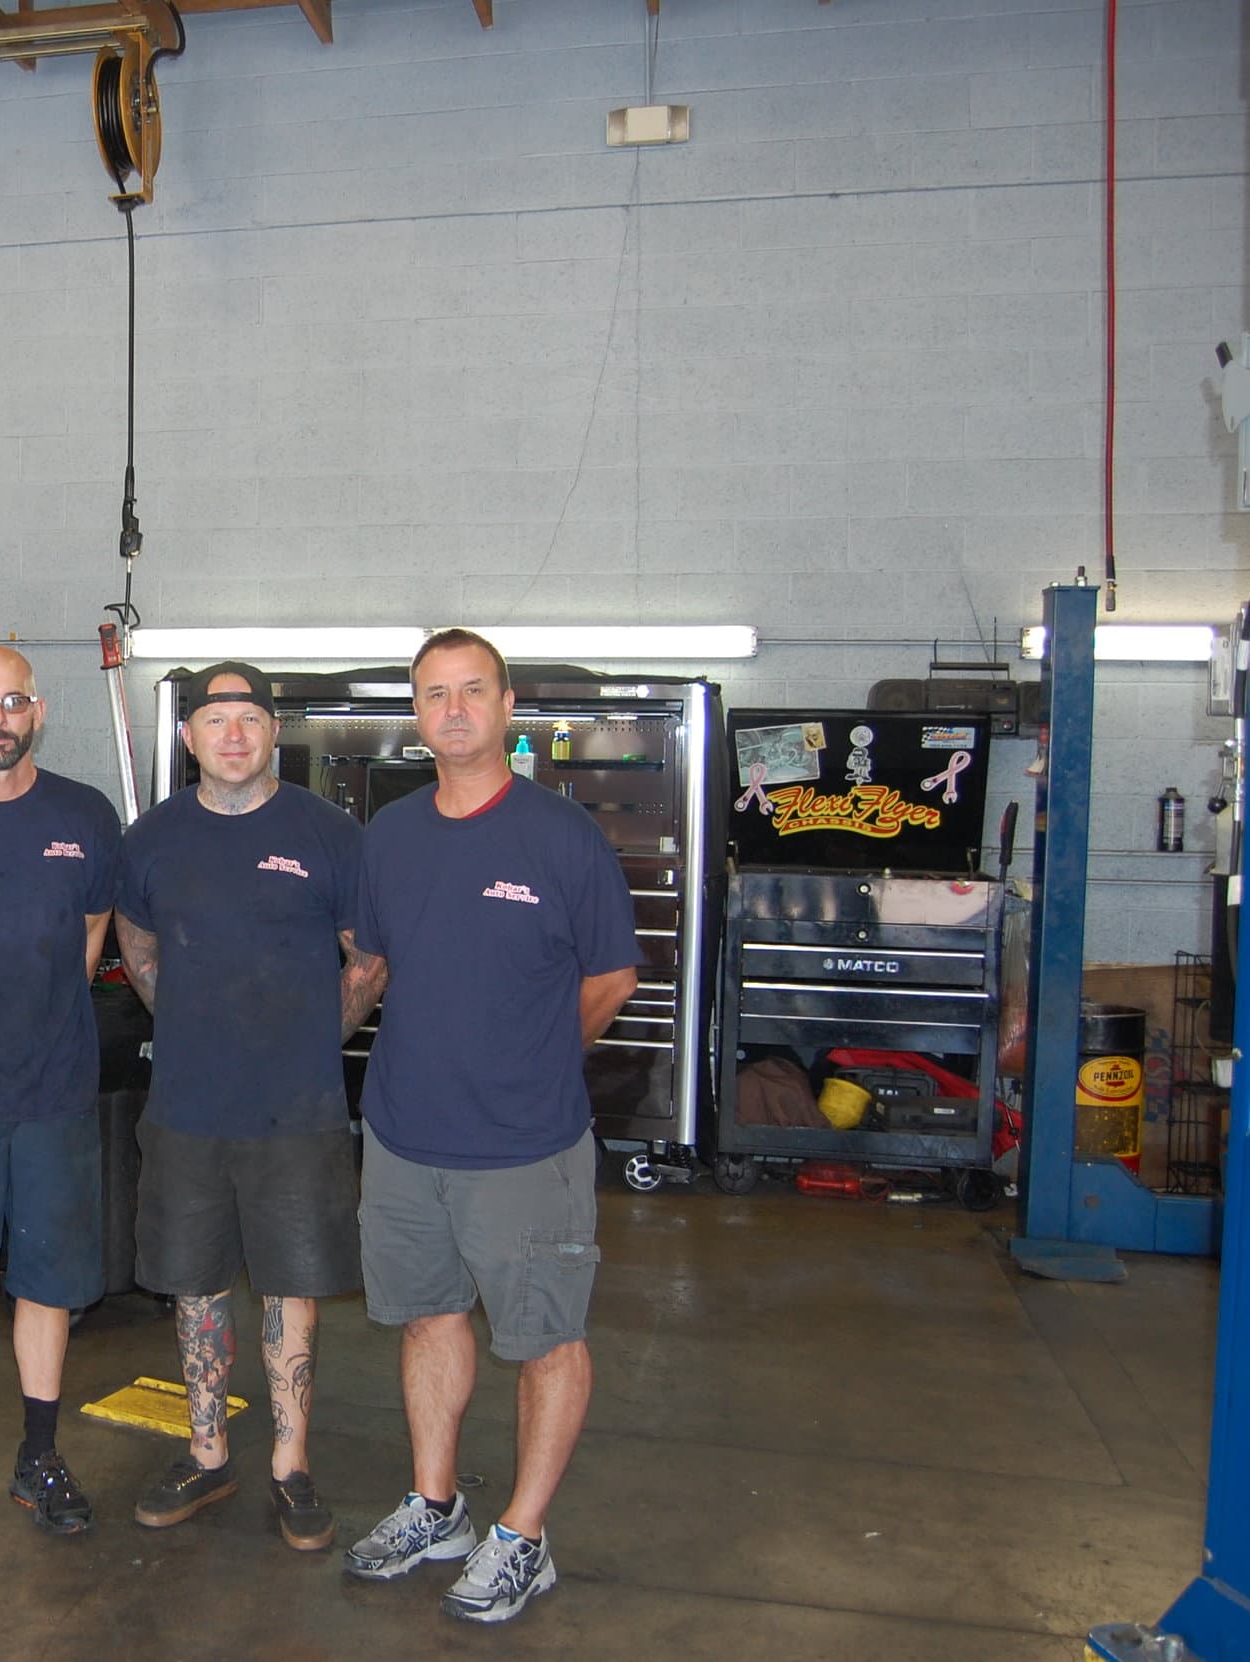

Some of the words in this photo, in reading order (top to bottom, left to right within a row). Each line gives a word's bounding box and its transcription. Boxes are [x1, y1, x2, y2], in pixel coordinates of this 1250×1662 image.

[851, 785, 941, 830] Flyer
[789, 817, 872, 832] CHASSIS
[837, 958, 900, 974] MATCO
[1093, 1068, 1135, 1082] PENNZOIL
